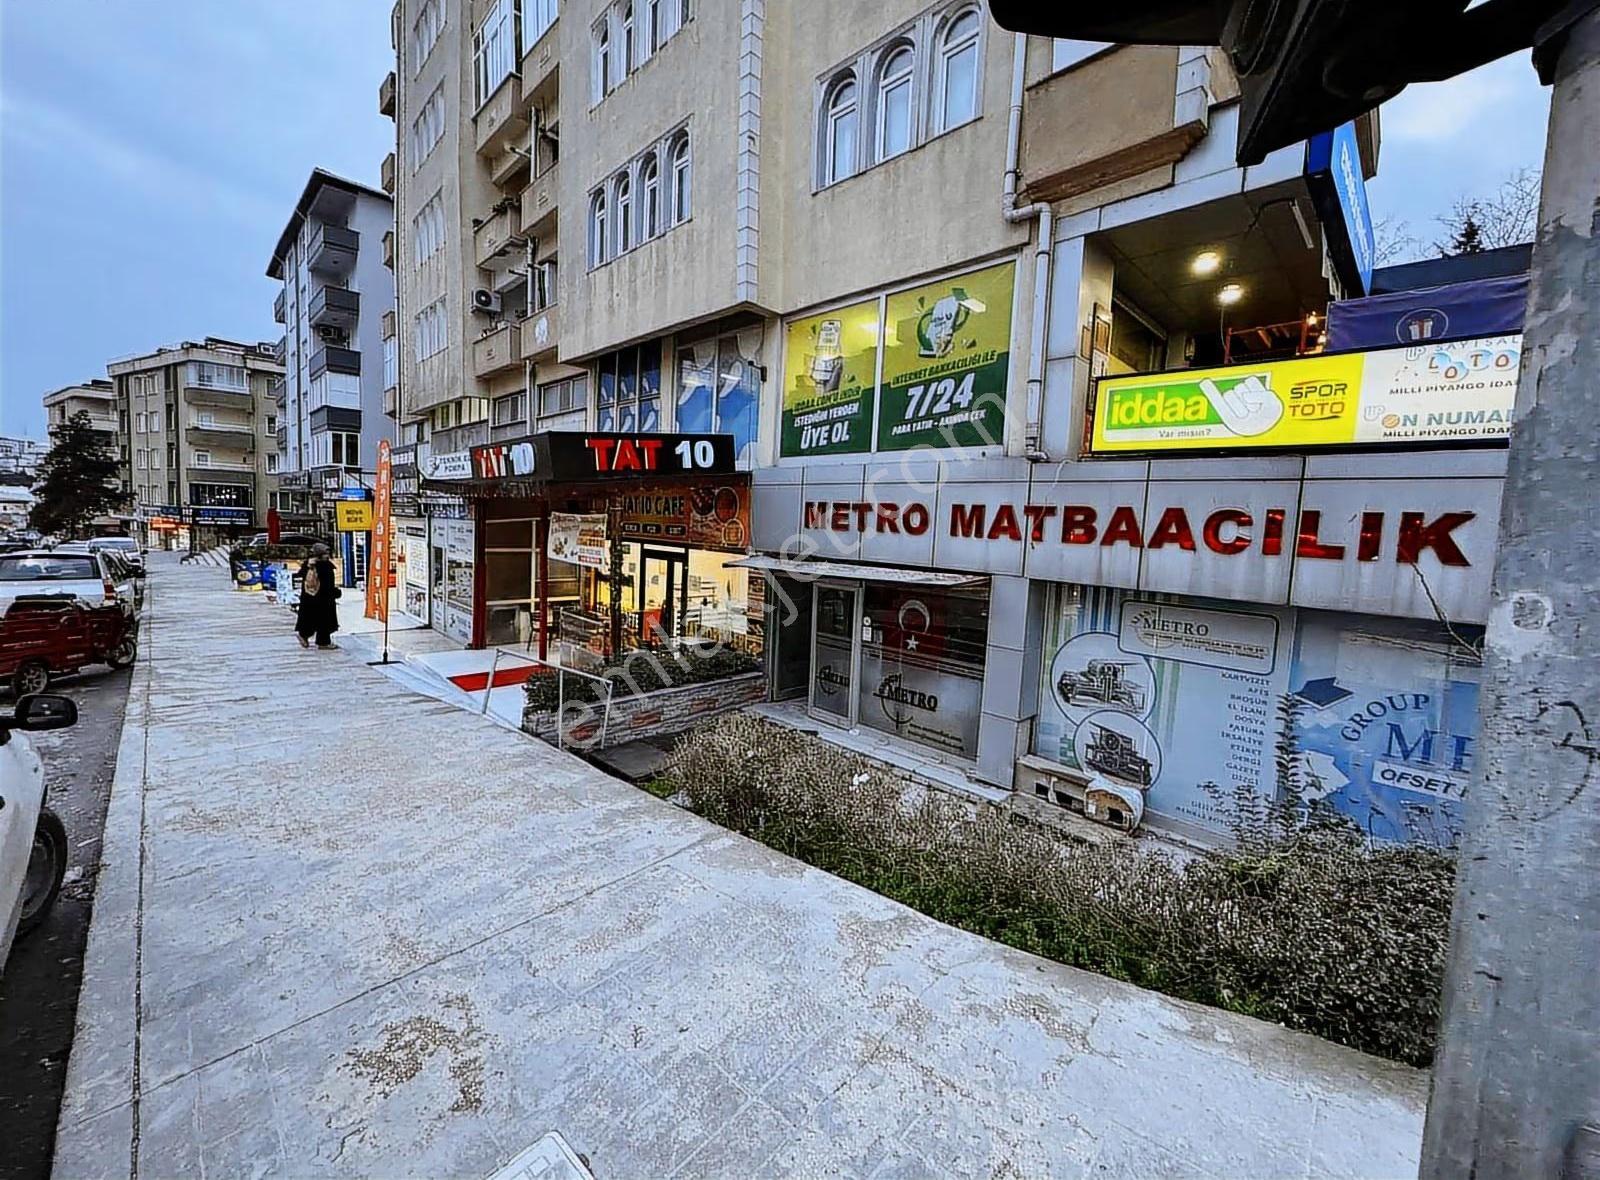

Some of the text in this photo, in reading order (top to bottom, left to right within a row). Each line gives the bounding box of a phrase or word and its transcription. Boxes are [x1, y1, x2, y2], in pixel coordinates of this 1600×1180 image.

[905, 373, 975, 420] 7/24
[1290, 384, 1348, 399] SPOR
[1111, 390, 1209, 425] iddaa
[1288, 401, 1345, 417] TOTO
[801, 420, 850, 449] ÜYE OL
[475, 442, 537, 478] TAT 10
[585, 439, 714, 471] TAT 10
[804, 501, 1477, 567] METRO MATBAACILIK
[1143, 616, 1209, 637] METRO
[887, 685, 938, 710] METRO
[1341, 694, 1430, 742] GROUP
[1380, 768, 1457, 794] OFSET
